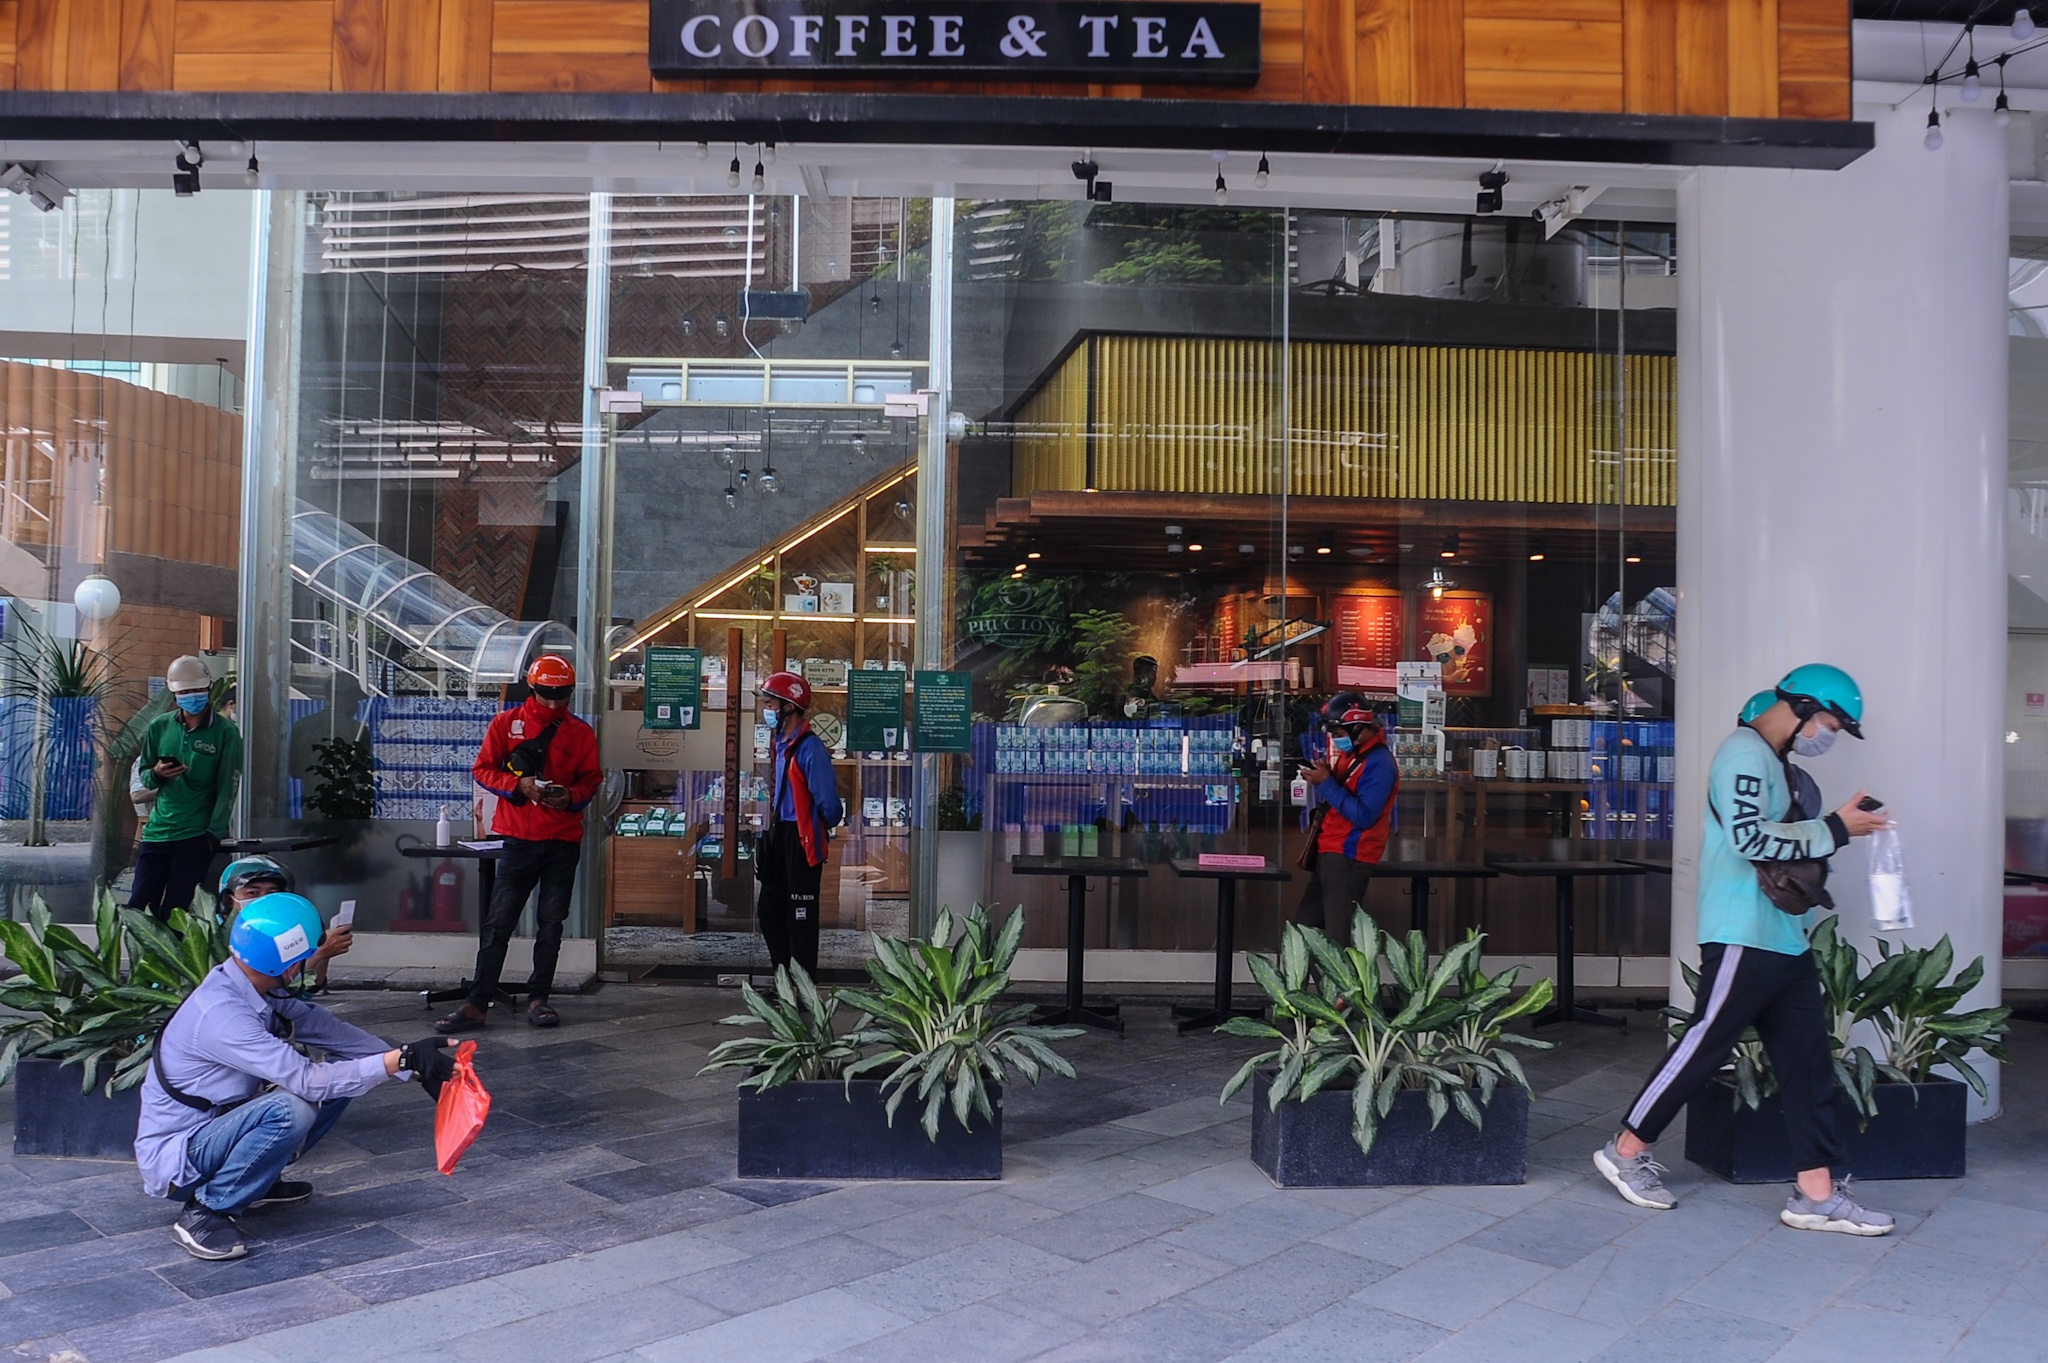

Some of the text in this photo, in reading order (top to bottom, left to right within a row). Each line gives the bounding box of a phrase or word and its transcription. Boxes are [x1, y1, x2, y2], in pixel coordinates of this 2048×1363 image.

[680, 14, 1225, 59] COFFEE & TEA
[1021, 619, 1067, 635] LONG
[194, 739, 217, 754] Grab
[725, 761, 736, 813] LONG
[1732, 774, 1811, 860] BAEMIN
[284, 937, 304, 951] UBER
